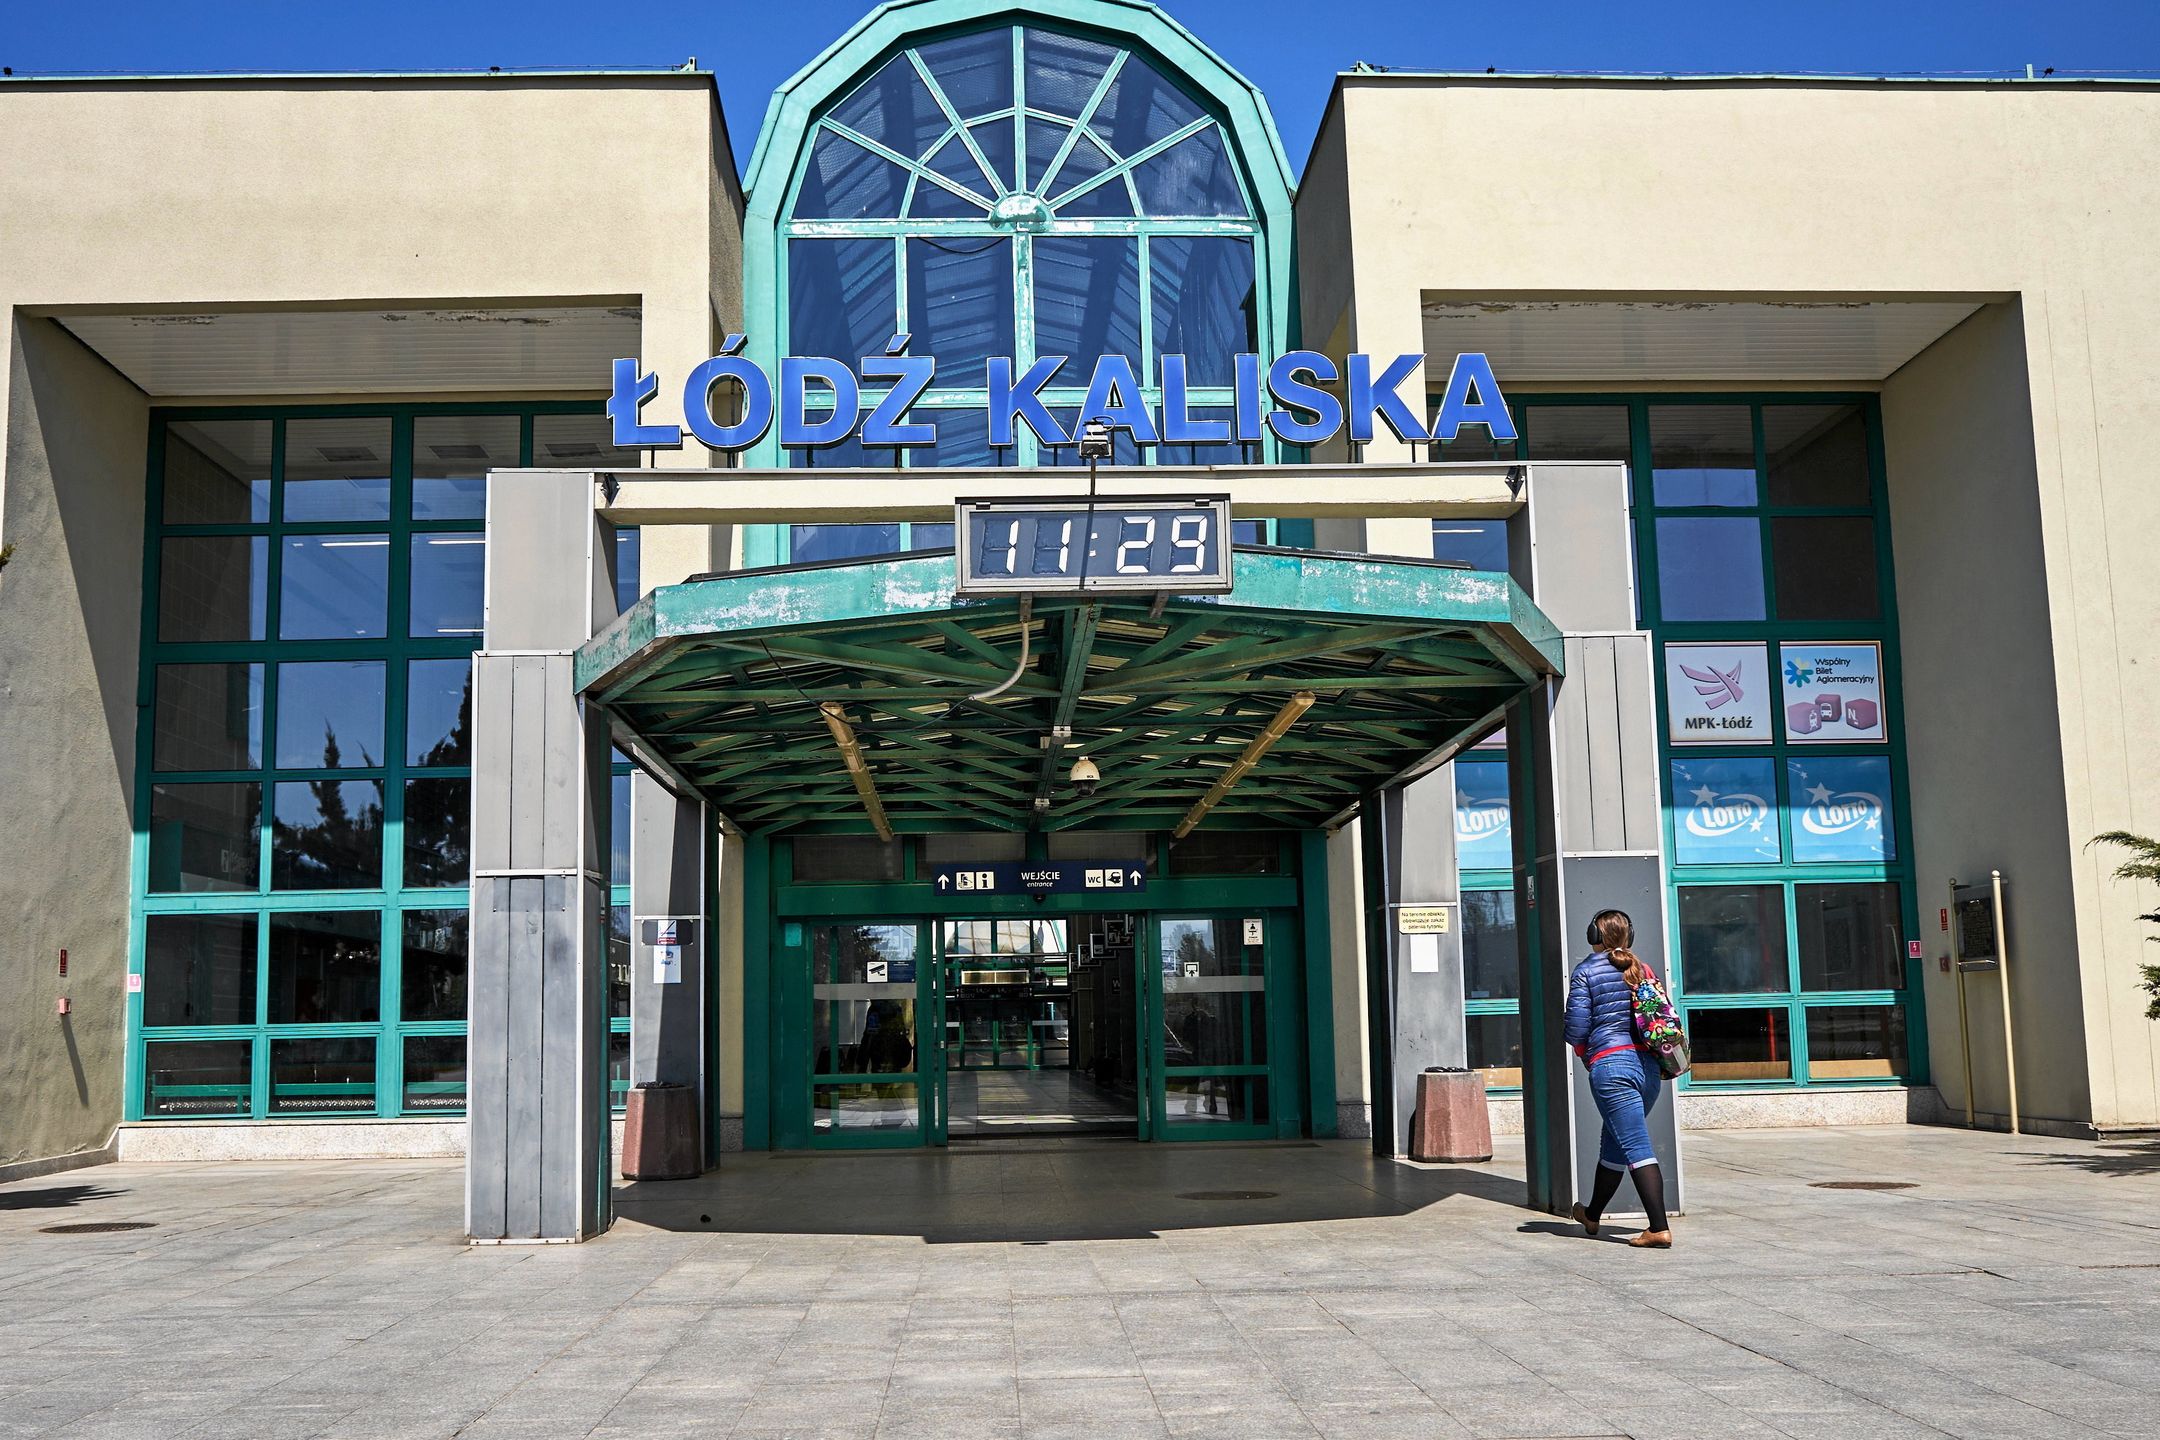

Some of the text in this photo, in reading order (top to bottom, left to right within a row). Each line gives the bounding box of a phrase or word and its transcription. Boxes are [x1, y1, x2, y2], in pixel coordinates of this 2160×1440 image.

[606, 333, 1519, 449] ŁÓDŹ KALISKA
[1005, 515, 1208, 574] 11:29
[1814, 657, 1851, 667] Wspólny
[1815, 667, 1833, 675] Bilet
[1816, 675, 1875, 685] Aglomeracyjny
[1685, 716, 1753, 729] MPK-Łódź
[1458, 806, 1508, 832] LOTTO
[1701, 802, 1752, 827] LOTTO
[1818, 799, 1868, 826] LOTTO
[1021, 870, 1061, 880] WEJŚCIE
